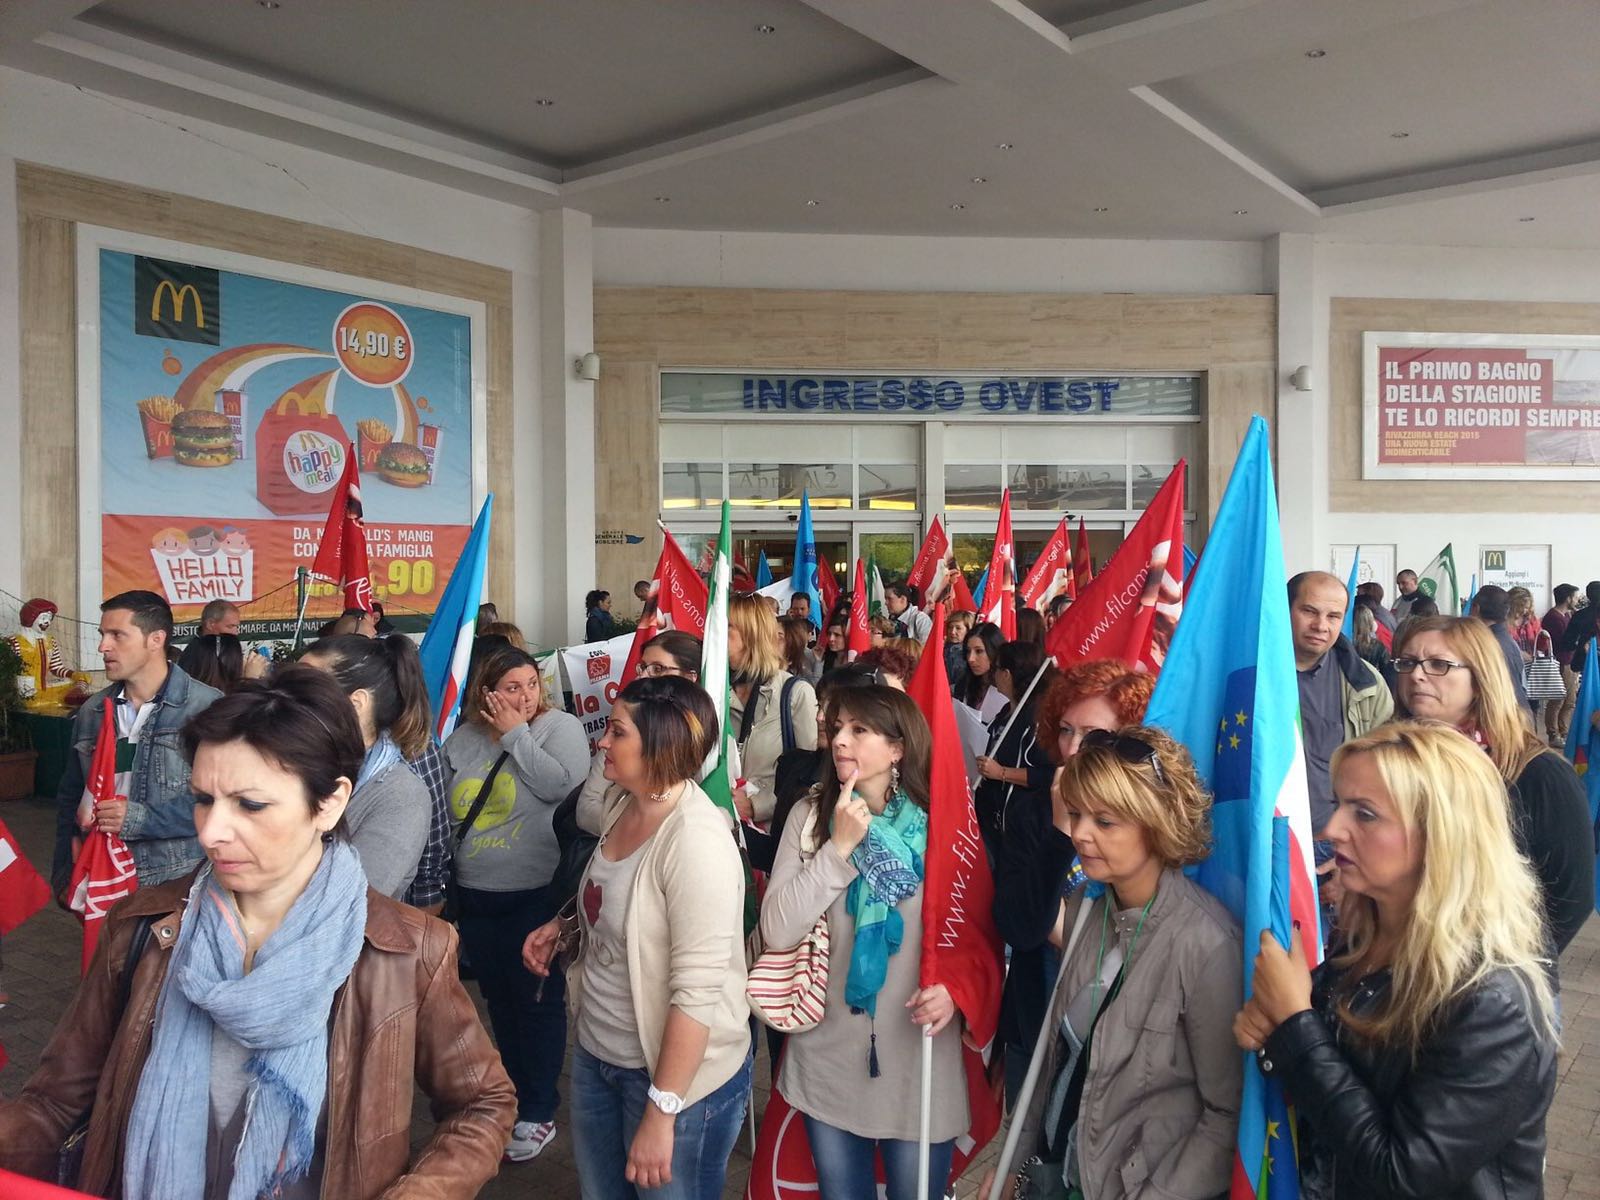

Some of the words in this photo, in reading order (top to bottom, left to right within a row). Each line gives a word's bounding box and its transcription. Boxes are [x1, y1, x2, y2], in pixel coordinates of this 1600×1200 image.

[340, 327, 389, 358] 14,90
[393, 335, 406, 360] €
[1385, 361, 1403, 380] IL
[1409, 361, 1472, 380] PRIMO
[1478, 362, 1542, 381] BAGNO
[743, 378, 965, 411] INGRESSO
[978, 379, 1120, 412] OVEST
[1385, 384, 1446, 403] DELLA
[1451, 385, 1542, 404] STAGIONE
[1385, 408, 1408, 427] TE
[1414, 408, 1438, 427] LO
[1444, 408, 1521, 427] RICORDI
[1430, 440, 1457, 448] ESTATE
[287, 444, 341, 474] happy
[306, 467, 334, 486] meal
[293, 527, 311, 540] DA
[397, 530, 434, 543] MANGI
[376, 545, 434, 558] FAMIGLIA
[166, 557, 244, 580] HELLO
[174, 579, 244, 601] FAMILY
[269, 623, 281, 633] DA
[575, 693, 600, 718] la
